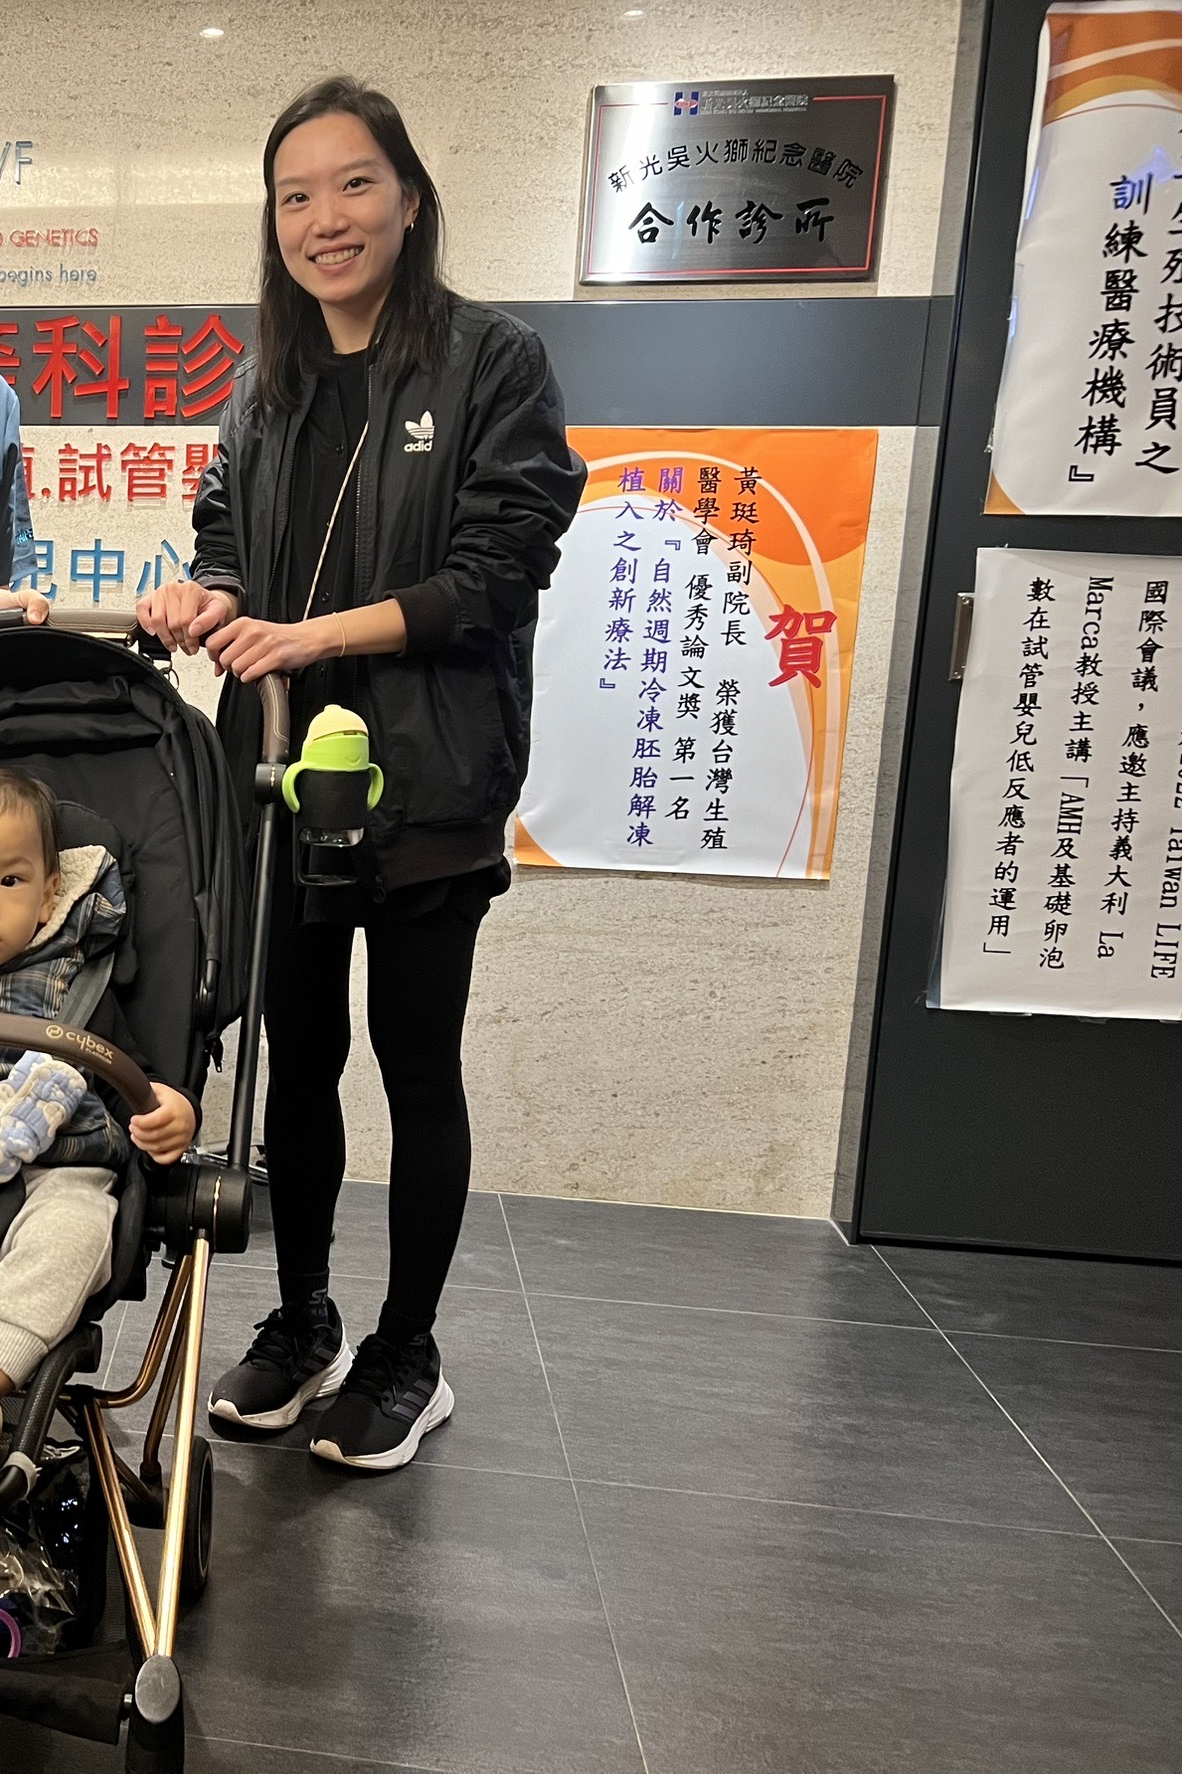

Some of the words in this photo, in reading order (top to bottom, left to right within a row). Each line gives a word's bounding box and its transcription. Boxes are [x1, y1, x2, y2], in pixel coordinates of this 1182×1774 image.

[608, 138, 863, 192] 新光吳火獅紀念醫院
[628, 197, 835, 244] 合作診所
[59, 263, 97, 284] here
[1068, 171, 1154, 483] 訓練醫療機構』
[763, 603, 838, 690] 賀
[664, 736, 697, 820] 第一名
[1097, 930, 1125, 959] La
[1150, 922, 1182, 980] LIFE
[65, 1031, 115, 1060] cybex
